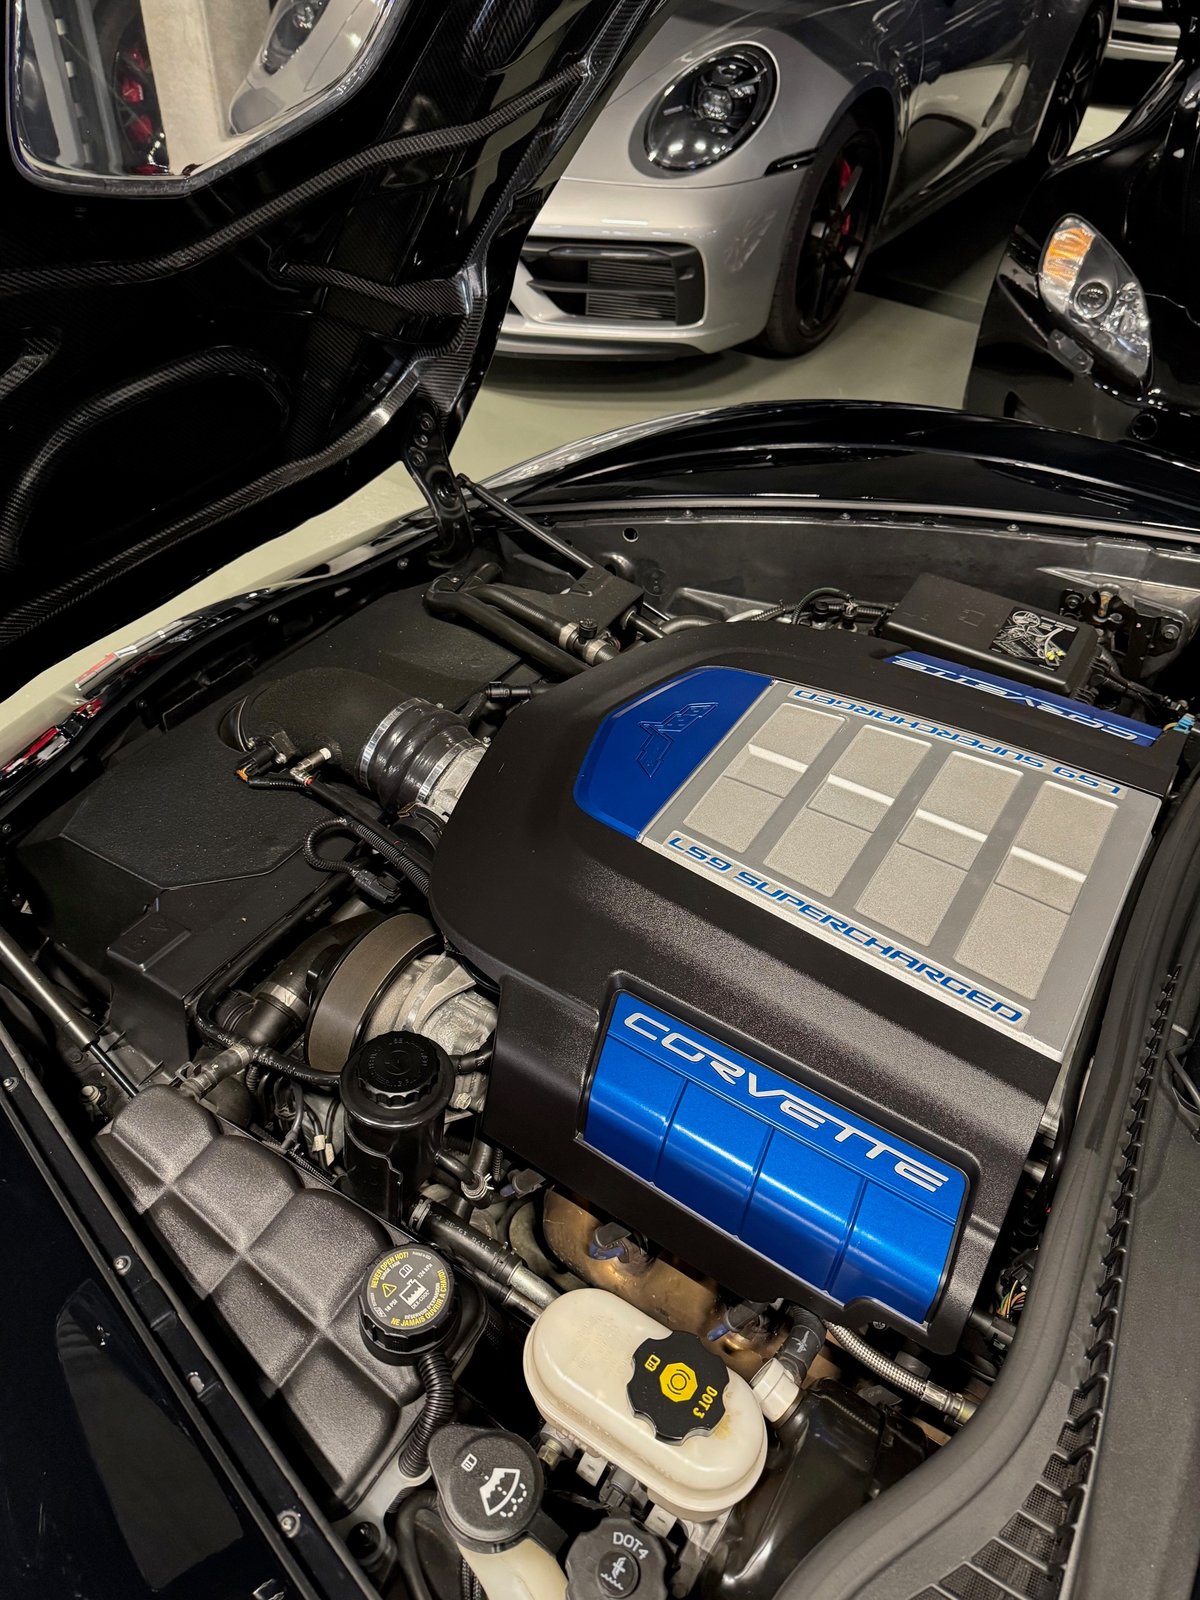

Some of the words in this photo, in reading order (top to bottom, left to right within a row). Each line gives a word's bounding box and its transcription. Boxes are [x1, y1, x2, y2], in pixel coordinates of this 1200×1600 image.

[892, 655, 1138, 742] CORVETTE
[793, 688, 1046, 771] SUPERCHARGED
[1052, 765, 1121, 796] LS9
[666, 837, 732, 873] LS9
[732, 870, 1024, 1024] SUPERCHARGED
[624, 1012, 949, 1193] CORVETTE
[371, 1268, 383, 1288] NEVER
[381, 1256, 395, 1270] OPEN
[394, 1252, 409, 1261] HOT!
[417, 1269, 426, 1279] 124
[384, 1304, 392, 1312] 18
[390, 1298, 398, 1308] PSI
[390, 1317, 400, 1326] NE
[400, 1316, 426, 1326] JAMAIS
[425, 1298, 443, 1319] OUVRIR
[692, 1407, 705, 1419] 3
[699, 1385, 718, 1412] DOT
